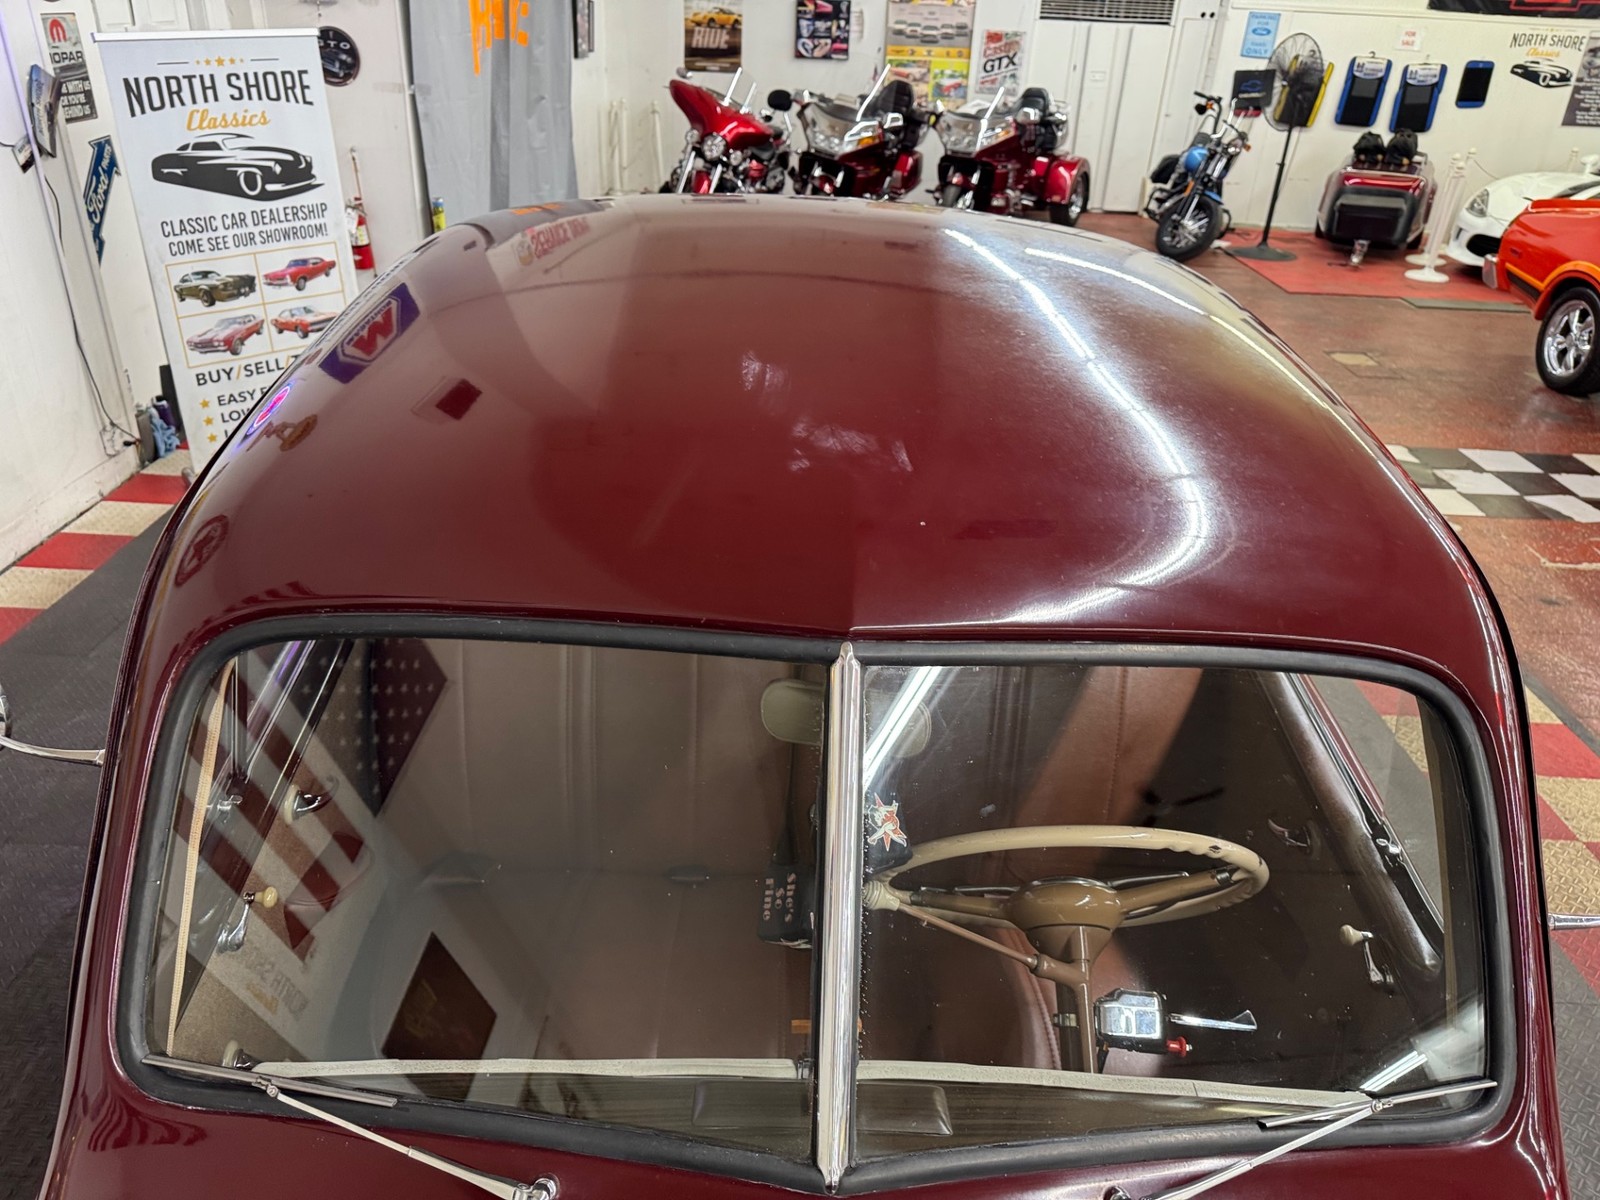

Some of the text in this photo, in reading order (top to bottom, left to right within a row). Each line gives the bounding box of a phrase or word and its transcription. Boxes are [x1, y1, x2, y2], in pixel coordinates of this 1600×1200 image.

[691, 26, 730, 49] RIDE
[1509, 33, 1586, 52] NORTH SHORE
[49, 50, 84, 64] OPAR
[983, 51, 1018, 73] GTX
[123, 69, 314, 118] NORTH SHORE
[186, 108, 272, 131] Classics
[87, 166, 109, 223] Ford
[160, 215, 218, 238] CLASSIC
[221, 211, 248, 231] CAR
[250, 202, 328, 227] DEALERSHIP
[168, 222, 328, 257] COME SEE OUR SHOWROOM!
[217, 389, 256, 406] EASY
[775, 887, 785, 909] So
